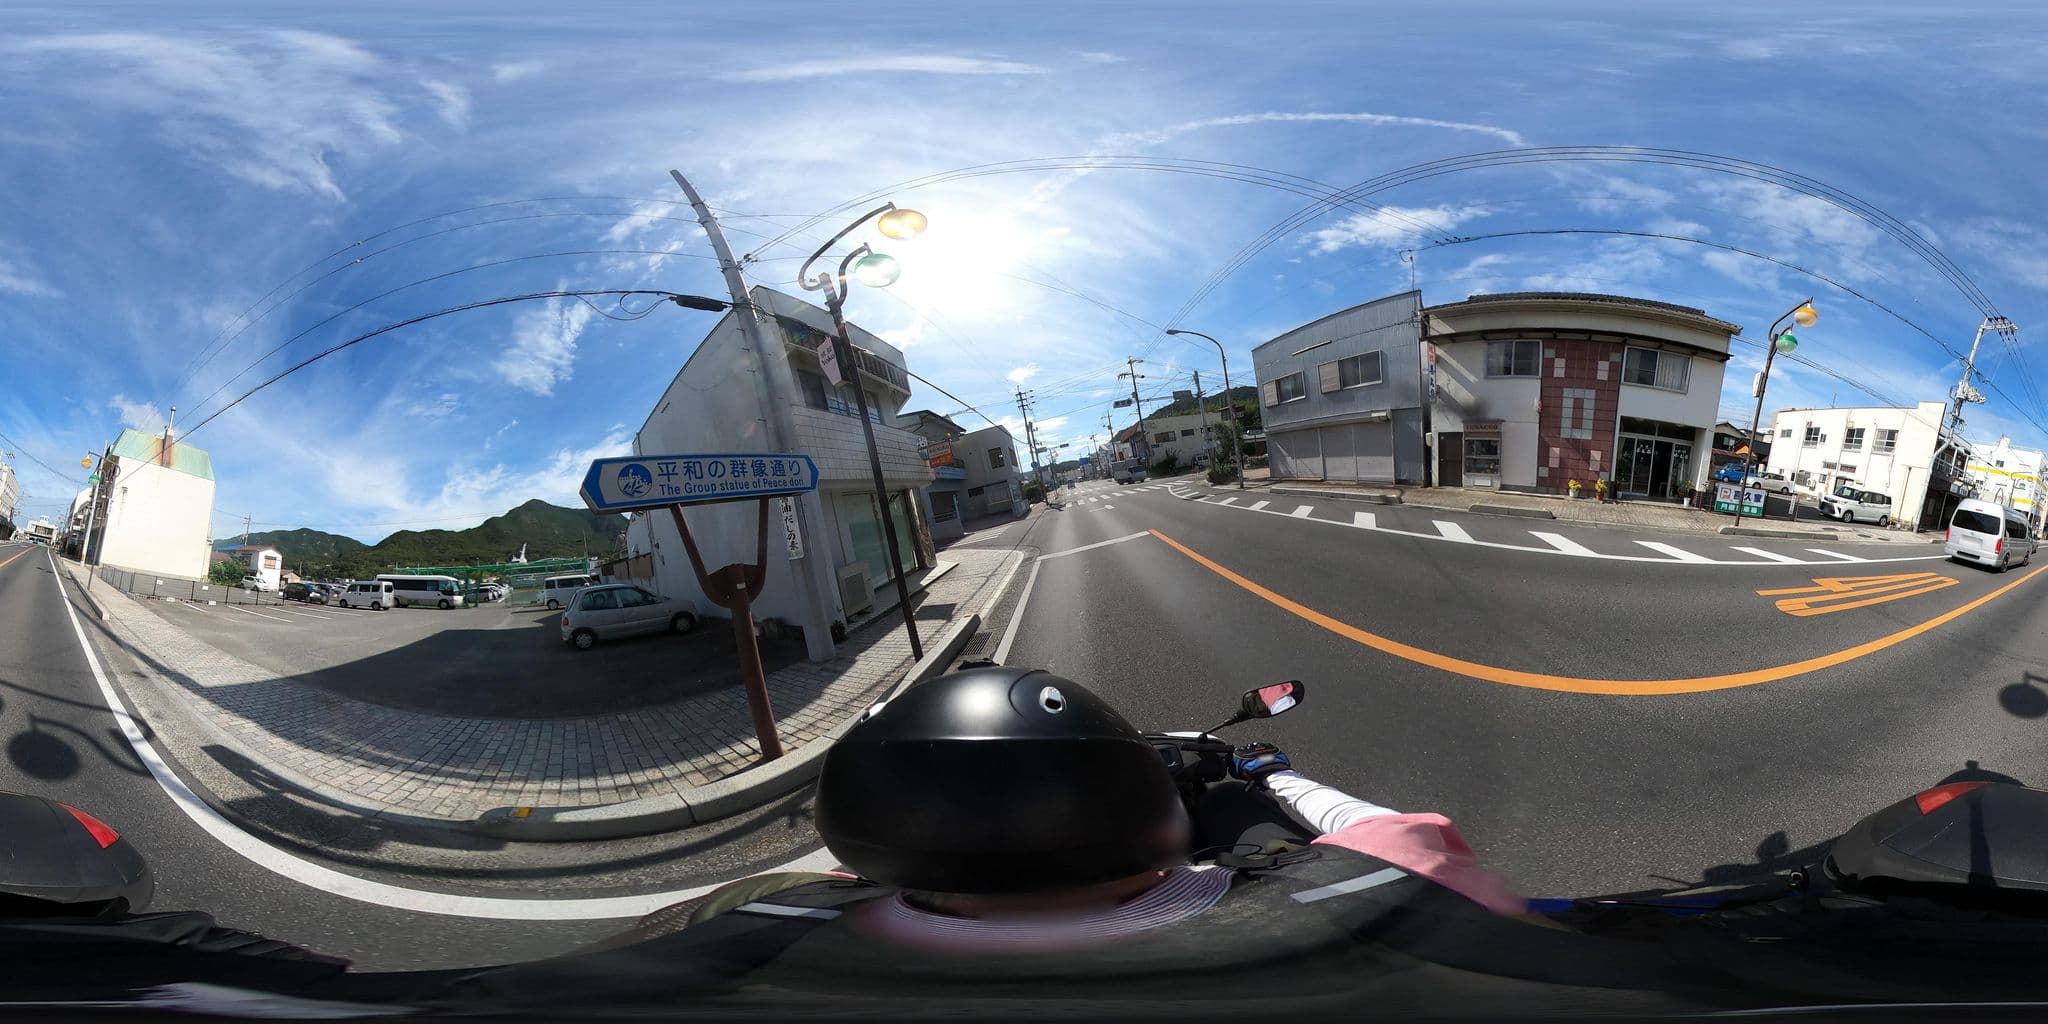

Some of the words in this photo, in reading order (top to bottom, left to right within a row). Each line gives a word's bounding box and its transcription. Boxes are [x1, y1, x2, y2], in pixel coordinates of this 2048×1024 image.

[657, 459, 801, 482] 平和の群像通り
[659, 483, 681, 496] The
[684, 482, 717, 494] Group
[720, 479, 750, 491] statue
[752, 479, 761, 488] of
[763, 478, 788, 488] Peace
[1721, 488, 1731, 499] P
[1755, 571, 1960, 617] 40
